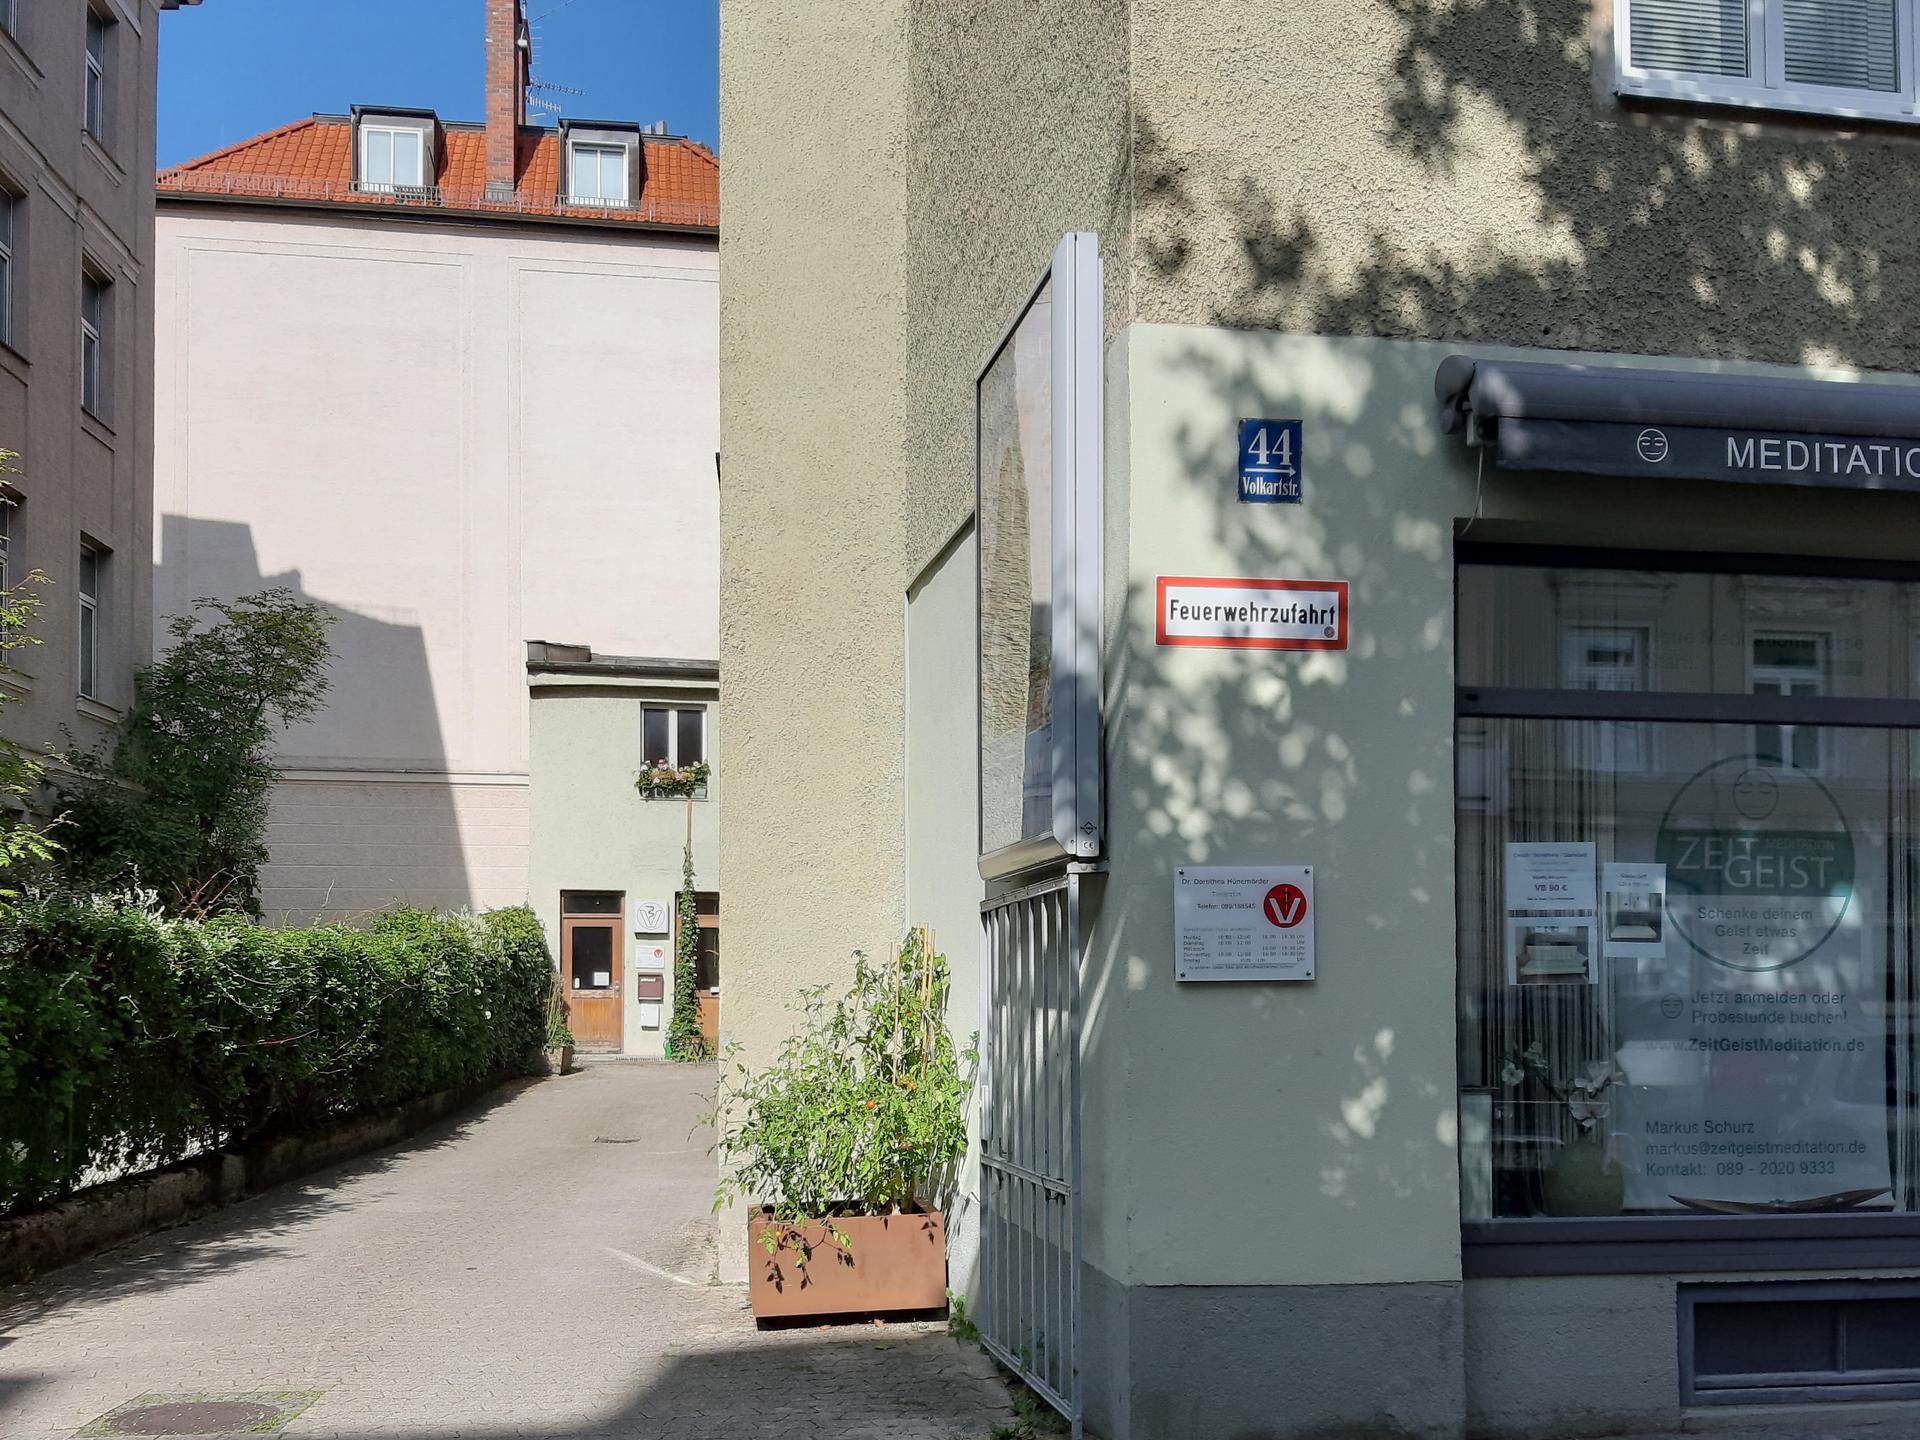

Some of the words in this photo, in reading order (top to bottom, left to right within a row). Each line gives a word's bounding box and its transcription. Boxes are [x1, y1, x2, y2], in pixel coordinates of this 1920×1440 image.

[1248, 428, 1293, 466] 44
[1243, 476, 1299, 497] Volkartstr.
[1170, 599, 1336, 626] Feuerwehrzufahrt
[1676, 837, 1760, 870] ZEIT
[1724, 855, 1834, 889] GEIST
[1697, 907, 1758, 921] Schenke
[1763, 907, 1813, 921] deinem
[1714, 925, 1752, 938] Geist
[1755, 926, 1797, 938] etwas
[1743, 943, 1769, 956] Zeit
[1691, 992, 1729, 1005] Jetzt
[1734, 991, 1807, 1005] anmelden
[1811, 991, 1847, 1005] oder
[1691, 1010, 1785, 1025] Probestunde
[1789, 1010, 1848, 1025] buchen!
[1645, 1120, 1699, 1134] Markus
[1703, 1120, 1755, 1134] Schurz
[1645, 1140, 1867, 1158] markus@zeitgeistmeditation.de
[1645, 1162, 1706, 1177] Kontakt:
[1716, 1162, 1744, 1176] 089
[1759, 1161, 1795, 1175] 2020
[1801, 1161, 1835, 1175] 9333
